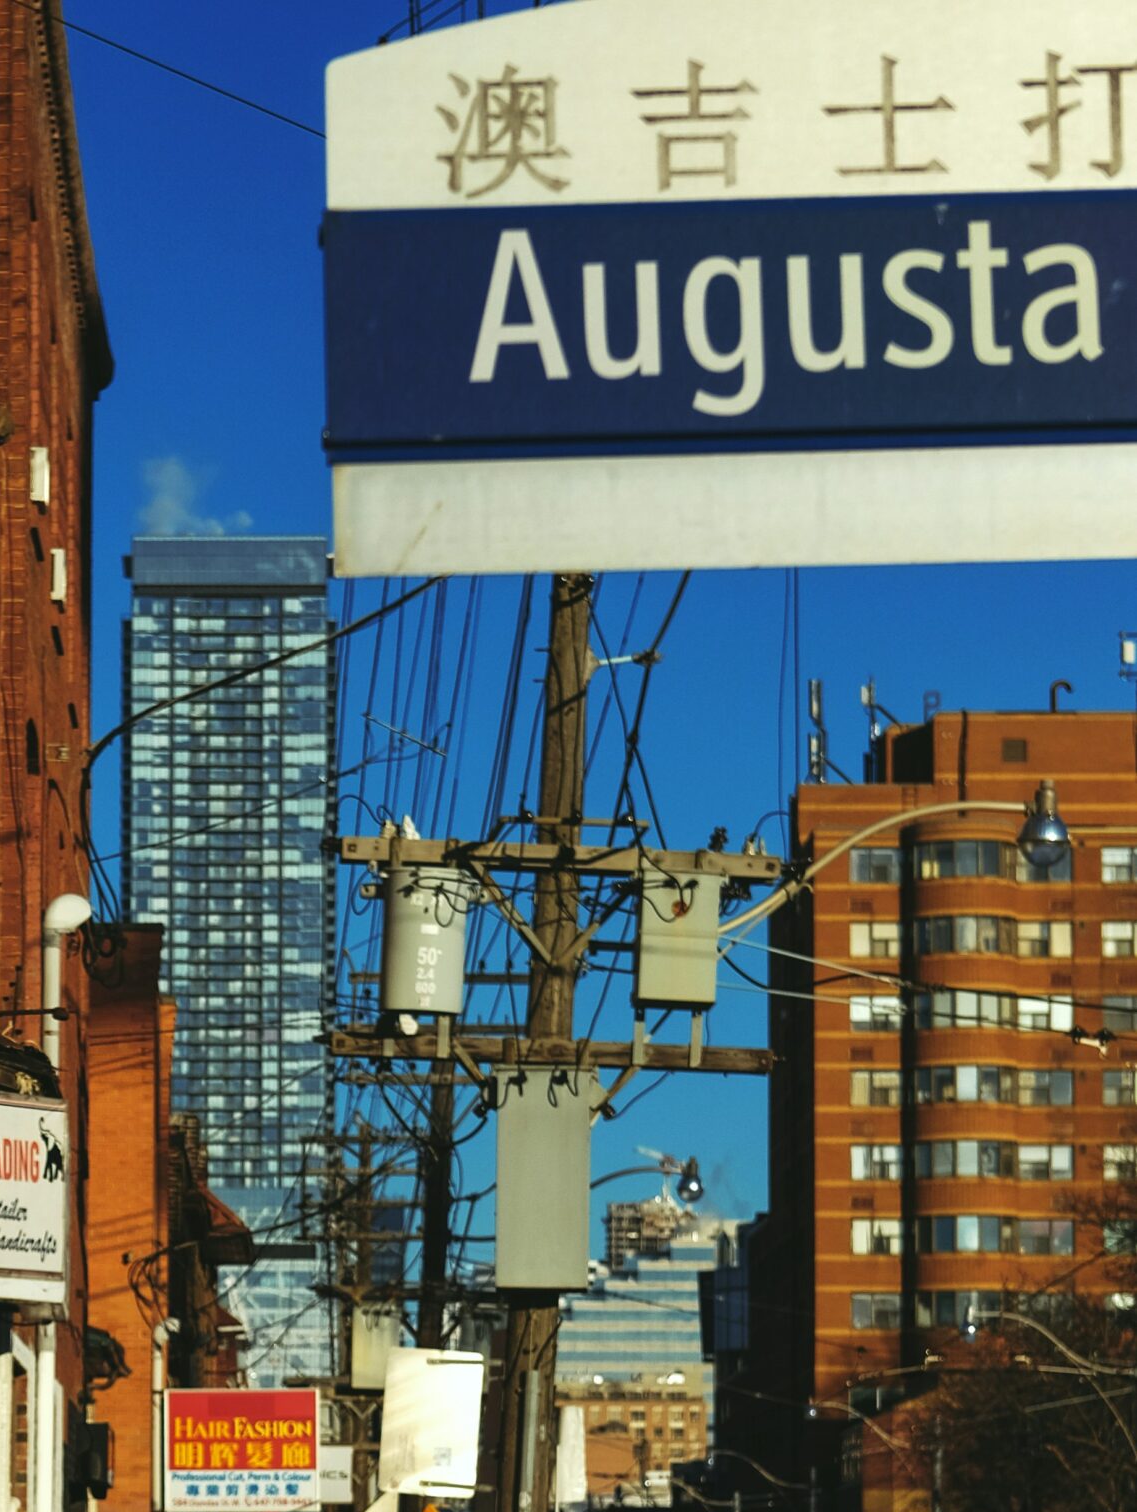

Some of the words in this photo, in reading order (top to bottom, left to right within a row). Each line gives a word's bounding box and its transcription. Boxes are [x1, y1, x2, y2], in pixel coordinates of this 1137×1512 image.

[435, 49, 1137, 198] 澳吉士打
[469, 220, 1104, 416] Augusta
[174, 1416, 232, 1440] HAIR
[233, 1416, 312, 1440] FASHION
